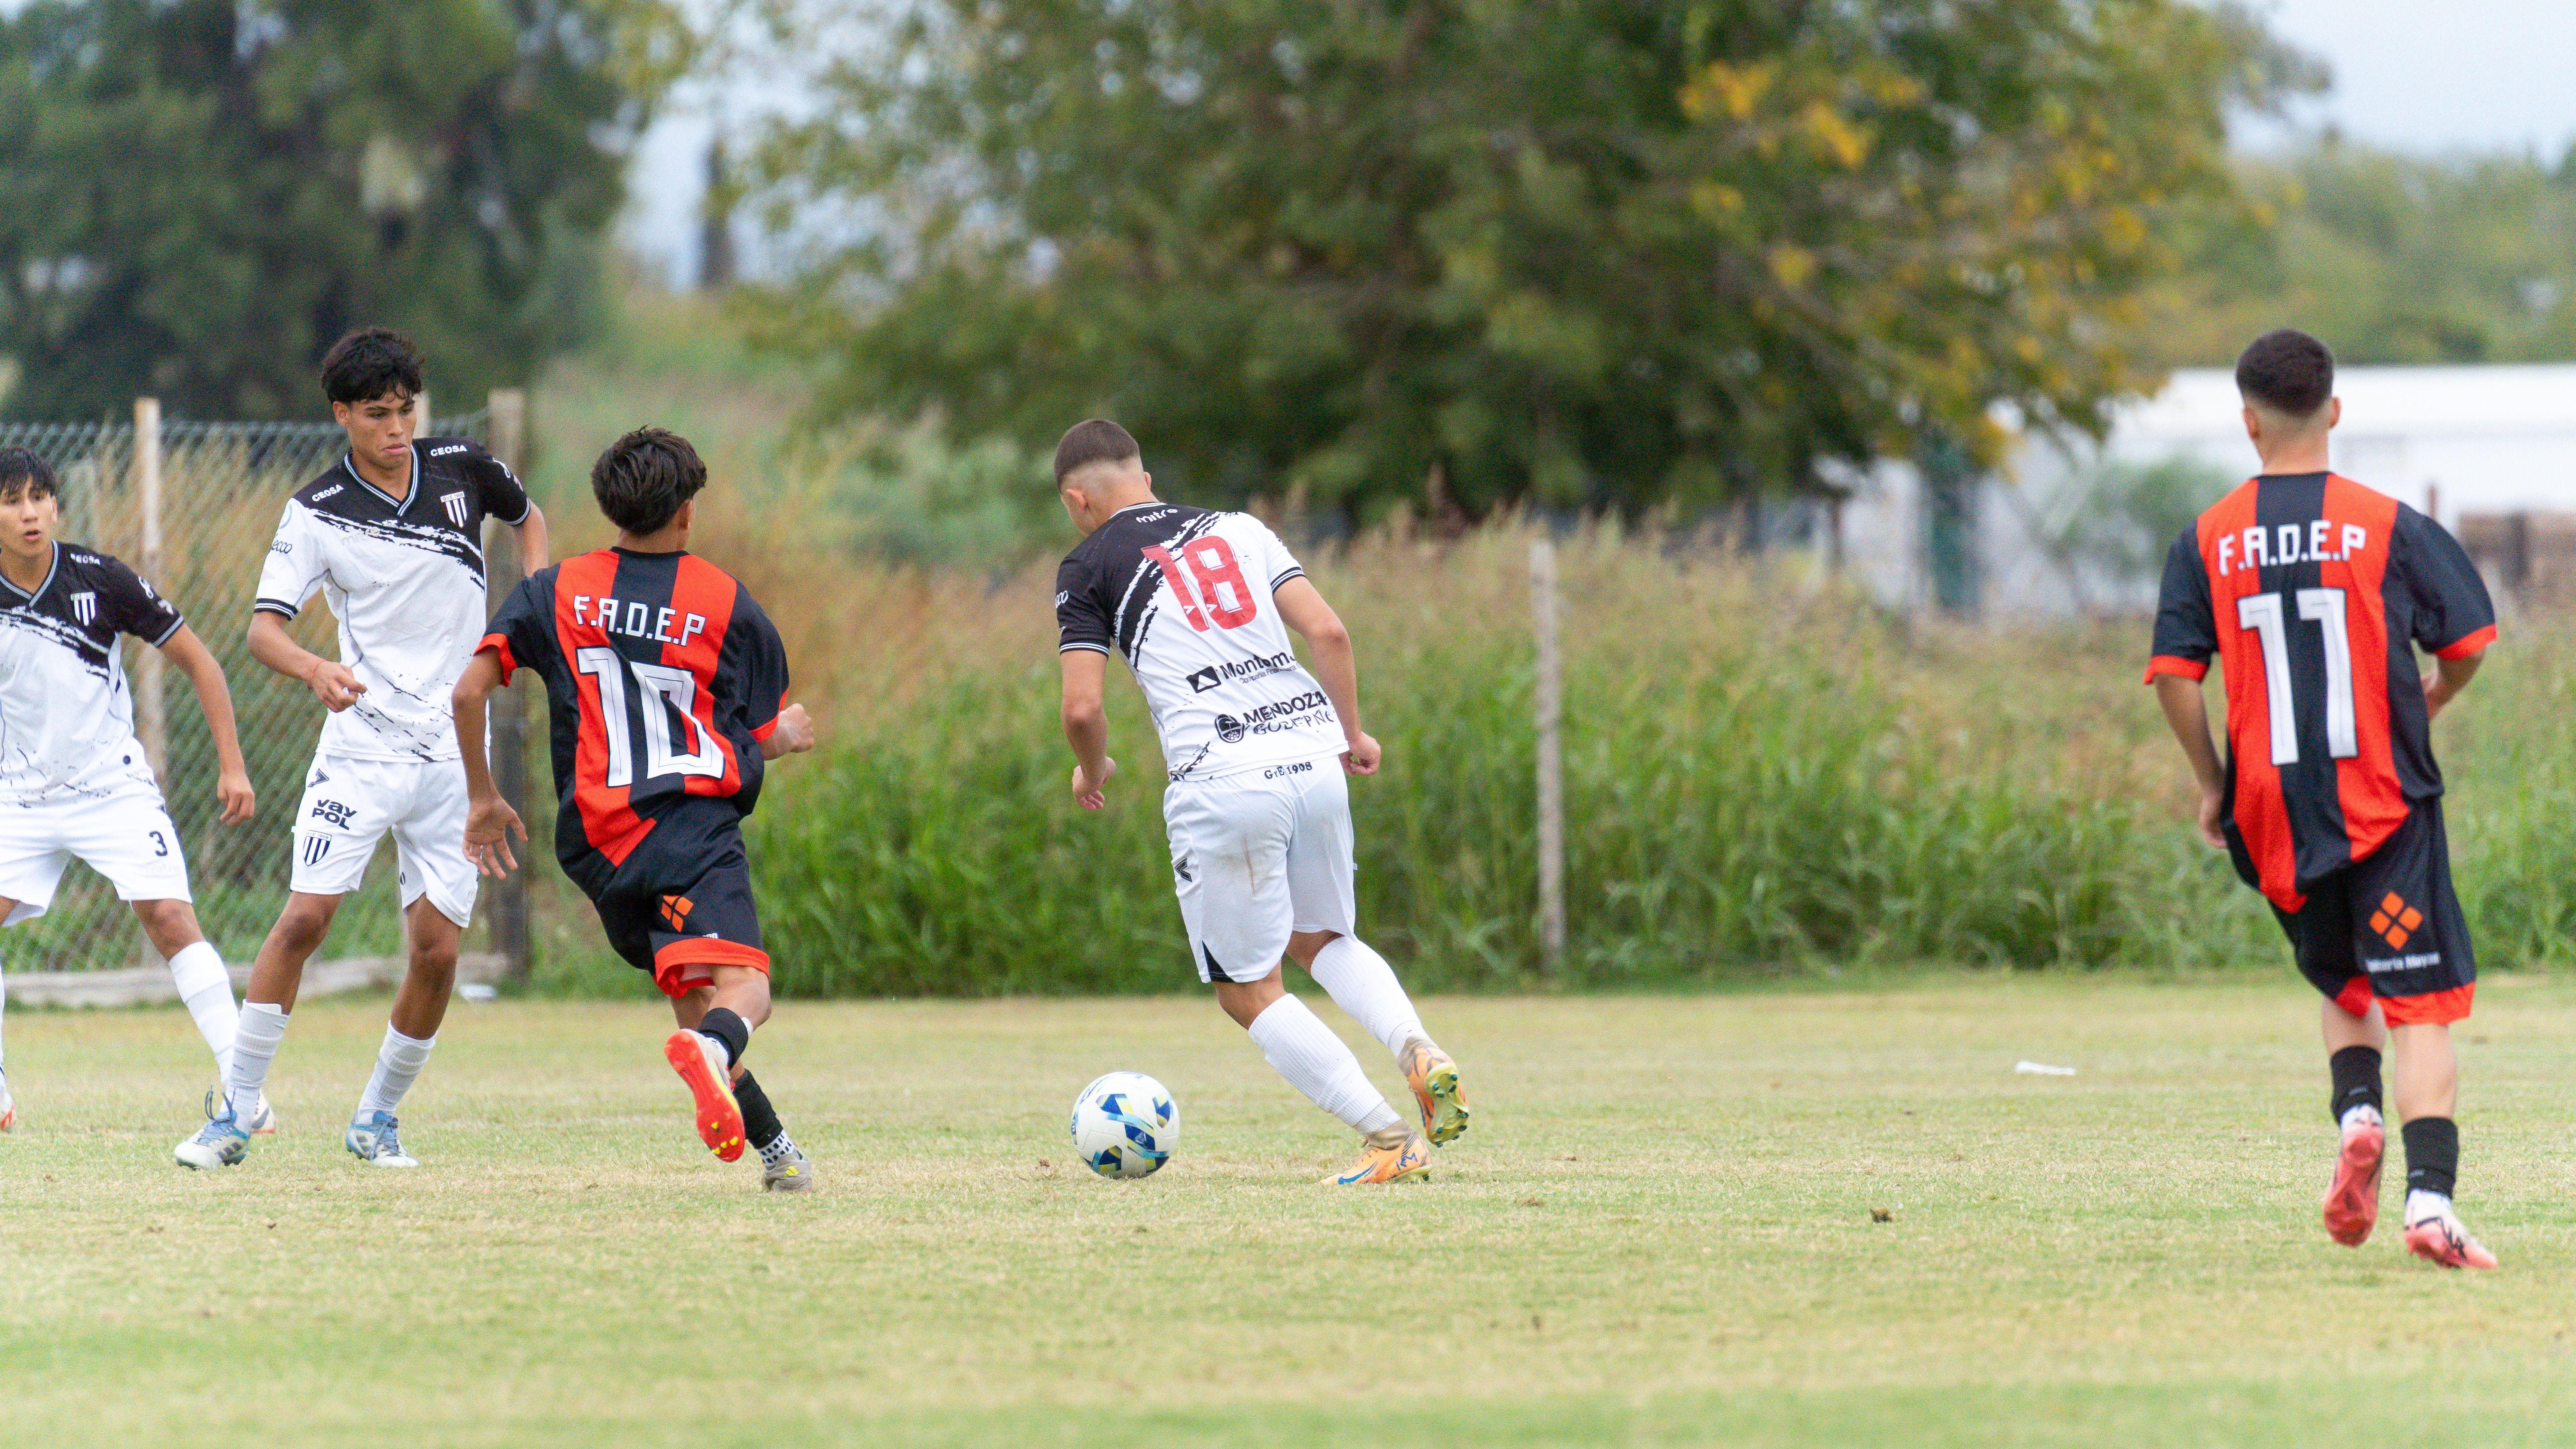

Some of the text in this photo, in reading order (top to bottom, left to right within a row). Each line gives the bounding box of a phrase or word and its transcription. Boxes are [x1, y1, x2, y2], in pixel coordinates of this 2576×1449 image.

[430, 445, 467, 457] CEOSA
[312, 484, 344, 502] CEOSA
[1136, 509, 1178, 523] mitre
[70, 553, 100, 565] CEOSA
[2218, 520, 2367, 576] F.A.D.E.P
[1140, 534, 1257, 632] 18
[574, 595, 706, 646] F.A.D.E.P
[2237, 588, 2358, 766] 11
[576, 646, 725, 787] 10
[1243, 691, 1327, 723] MENDOZA
[1287, 761, 1312, 774] 1908
[311, 807, 350, 831] POL
[317, 799, 358, 818] vay
[149, 831, 168, 857] 3
